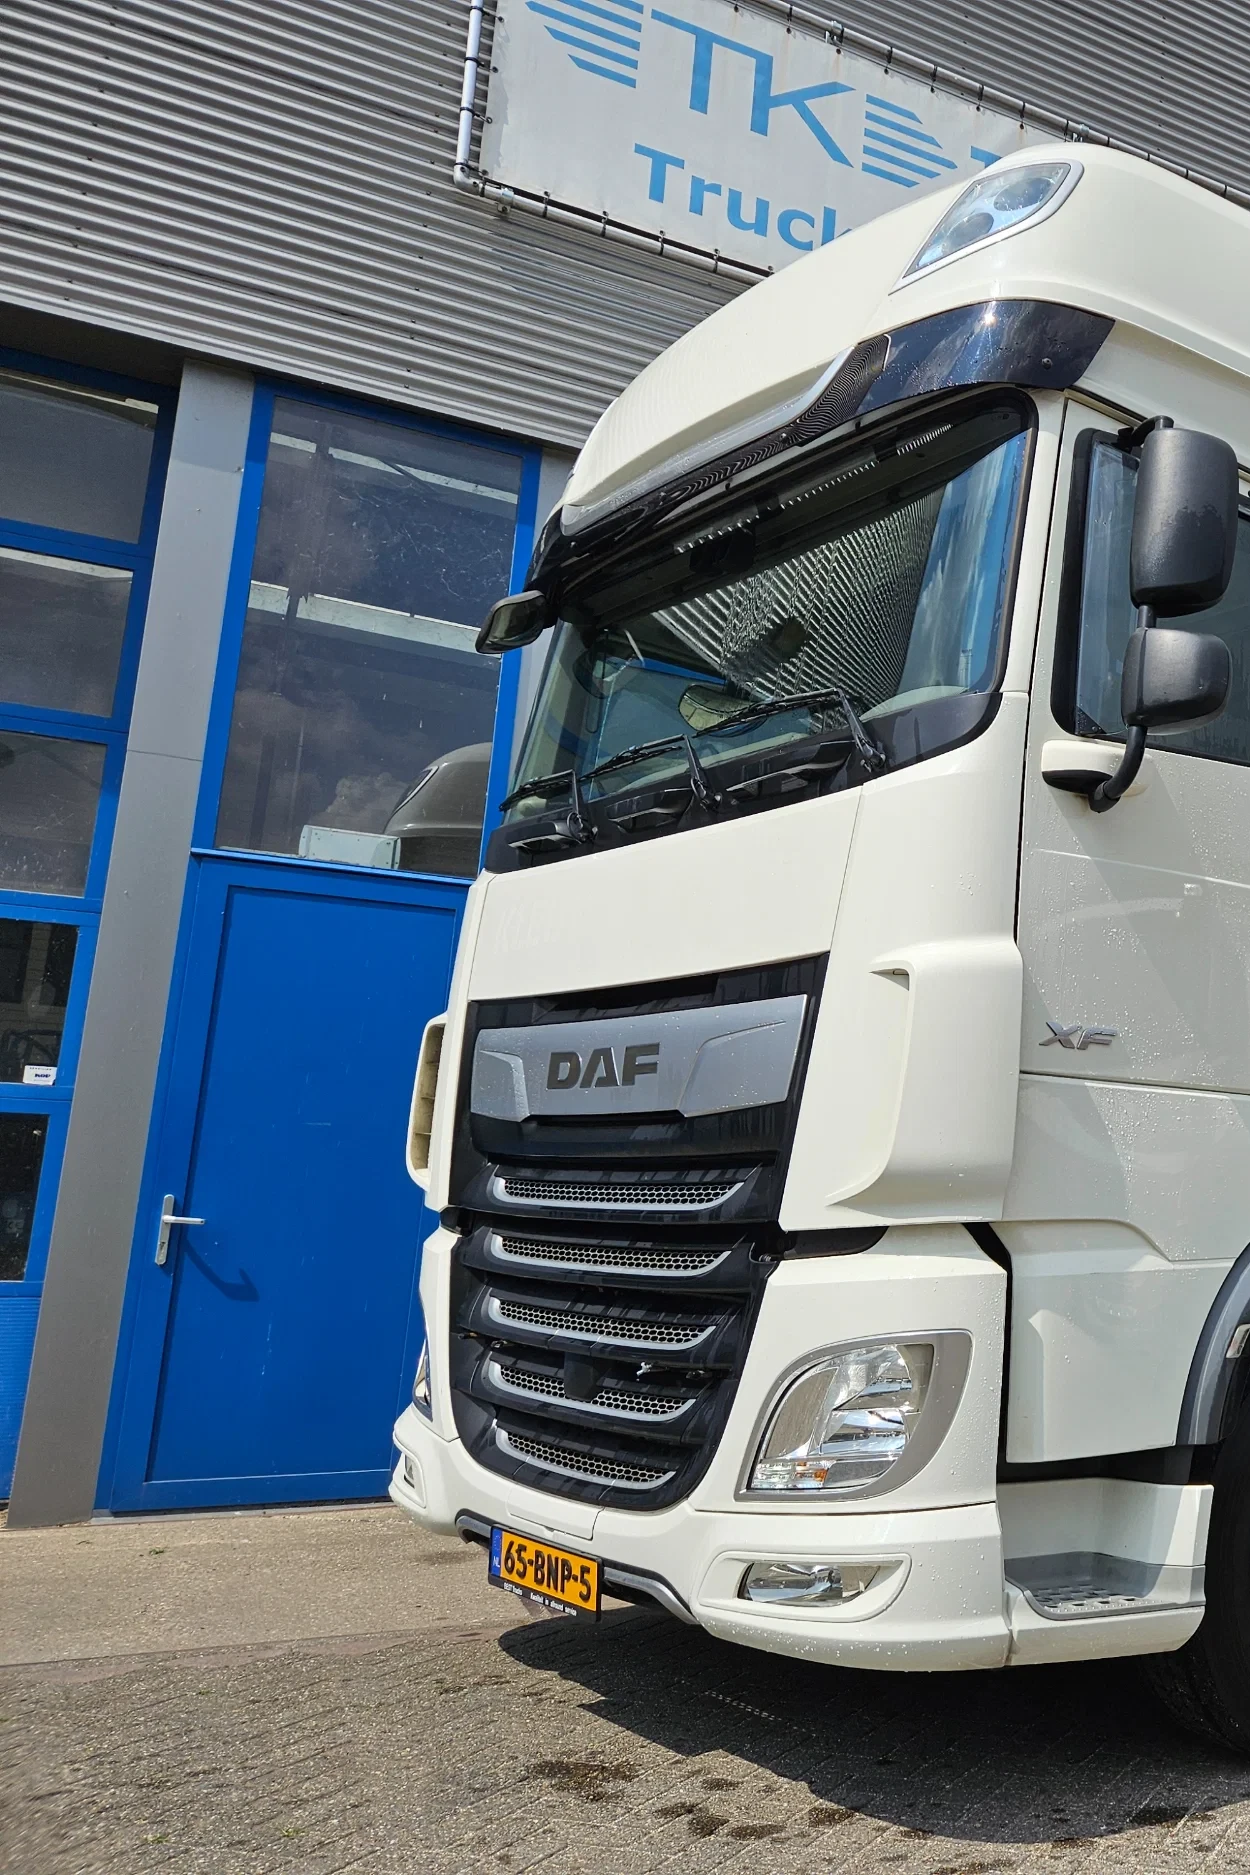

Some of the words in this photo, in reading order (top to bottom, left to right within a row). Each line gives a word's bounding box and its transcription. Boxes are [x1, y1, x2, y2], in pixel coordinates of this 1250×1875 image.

[1038, 1021, 1118, 1051] XF
[546, 1042, 660, 1090] DAF
[503, 1540, 592, 1604] 65-BNP-5
